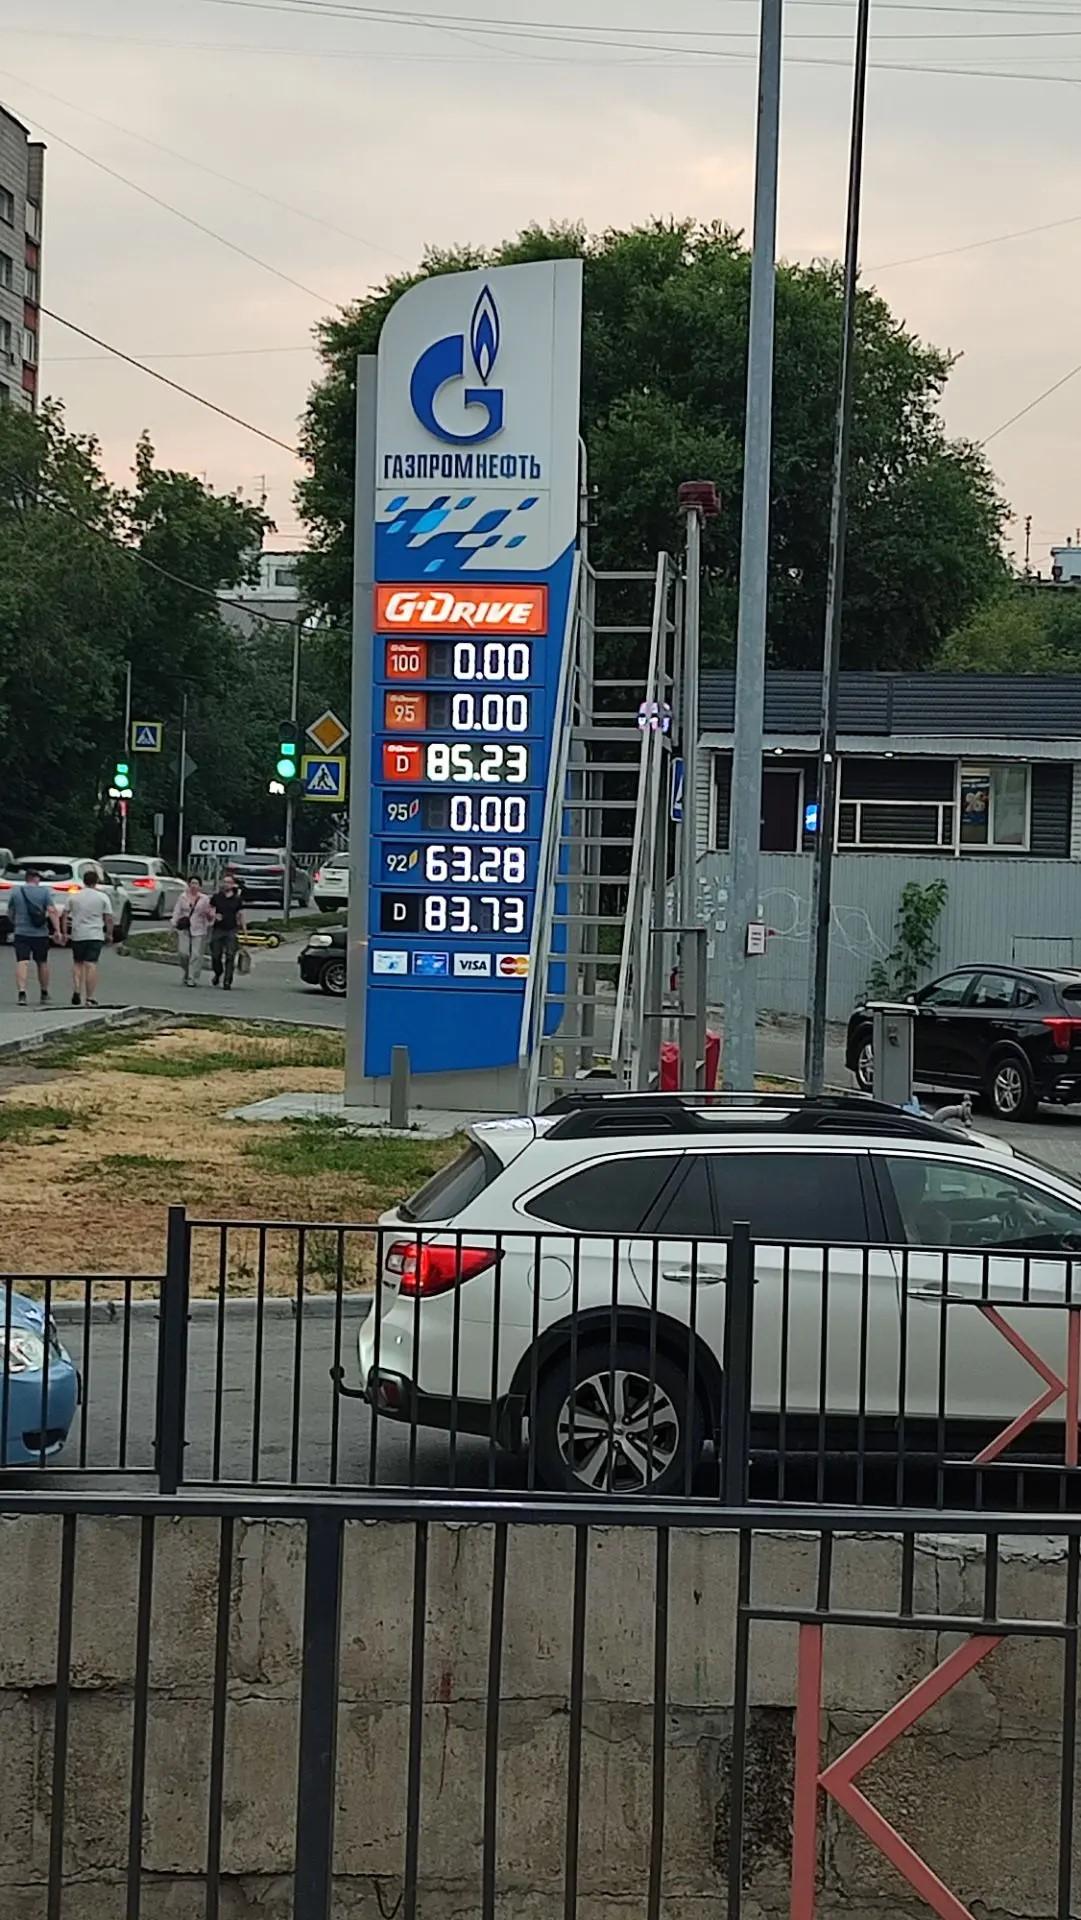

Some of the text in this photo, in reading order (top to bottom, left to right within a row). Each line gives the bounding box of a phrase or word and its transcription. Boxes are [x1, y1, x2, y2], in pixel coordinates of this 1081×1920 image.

[384, 453, 541, 480] ГАЗПРОМНЕФТЬ
[390, 642, 530, 681] 100 0.00
[394, 693, 528, 732] 95 0.00
[396, 743, 528, 783] D 85.23
[387, 795, 526, 833] 95 0.00
[386, 845, 526, 884] 92 63.28
[392, 896, 525, 934] D 83.73
[459, 959, 488, 971] VISA
